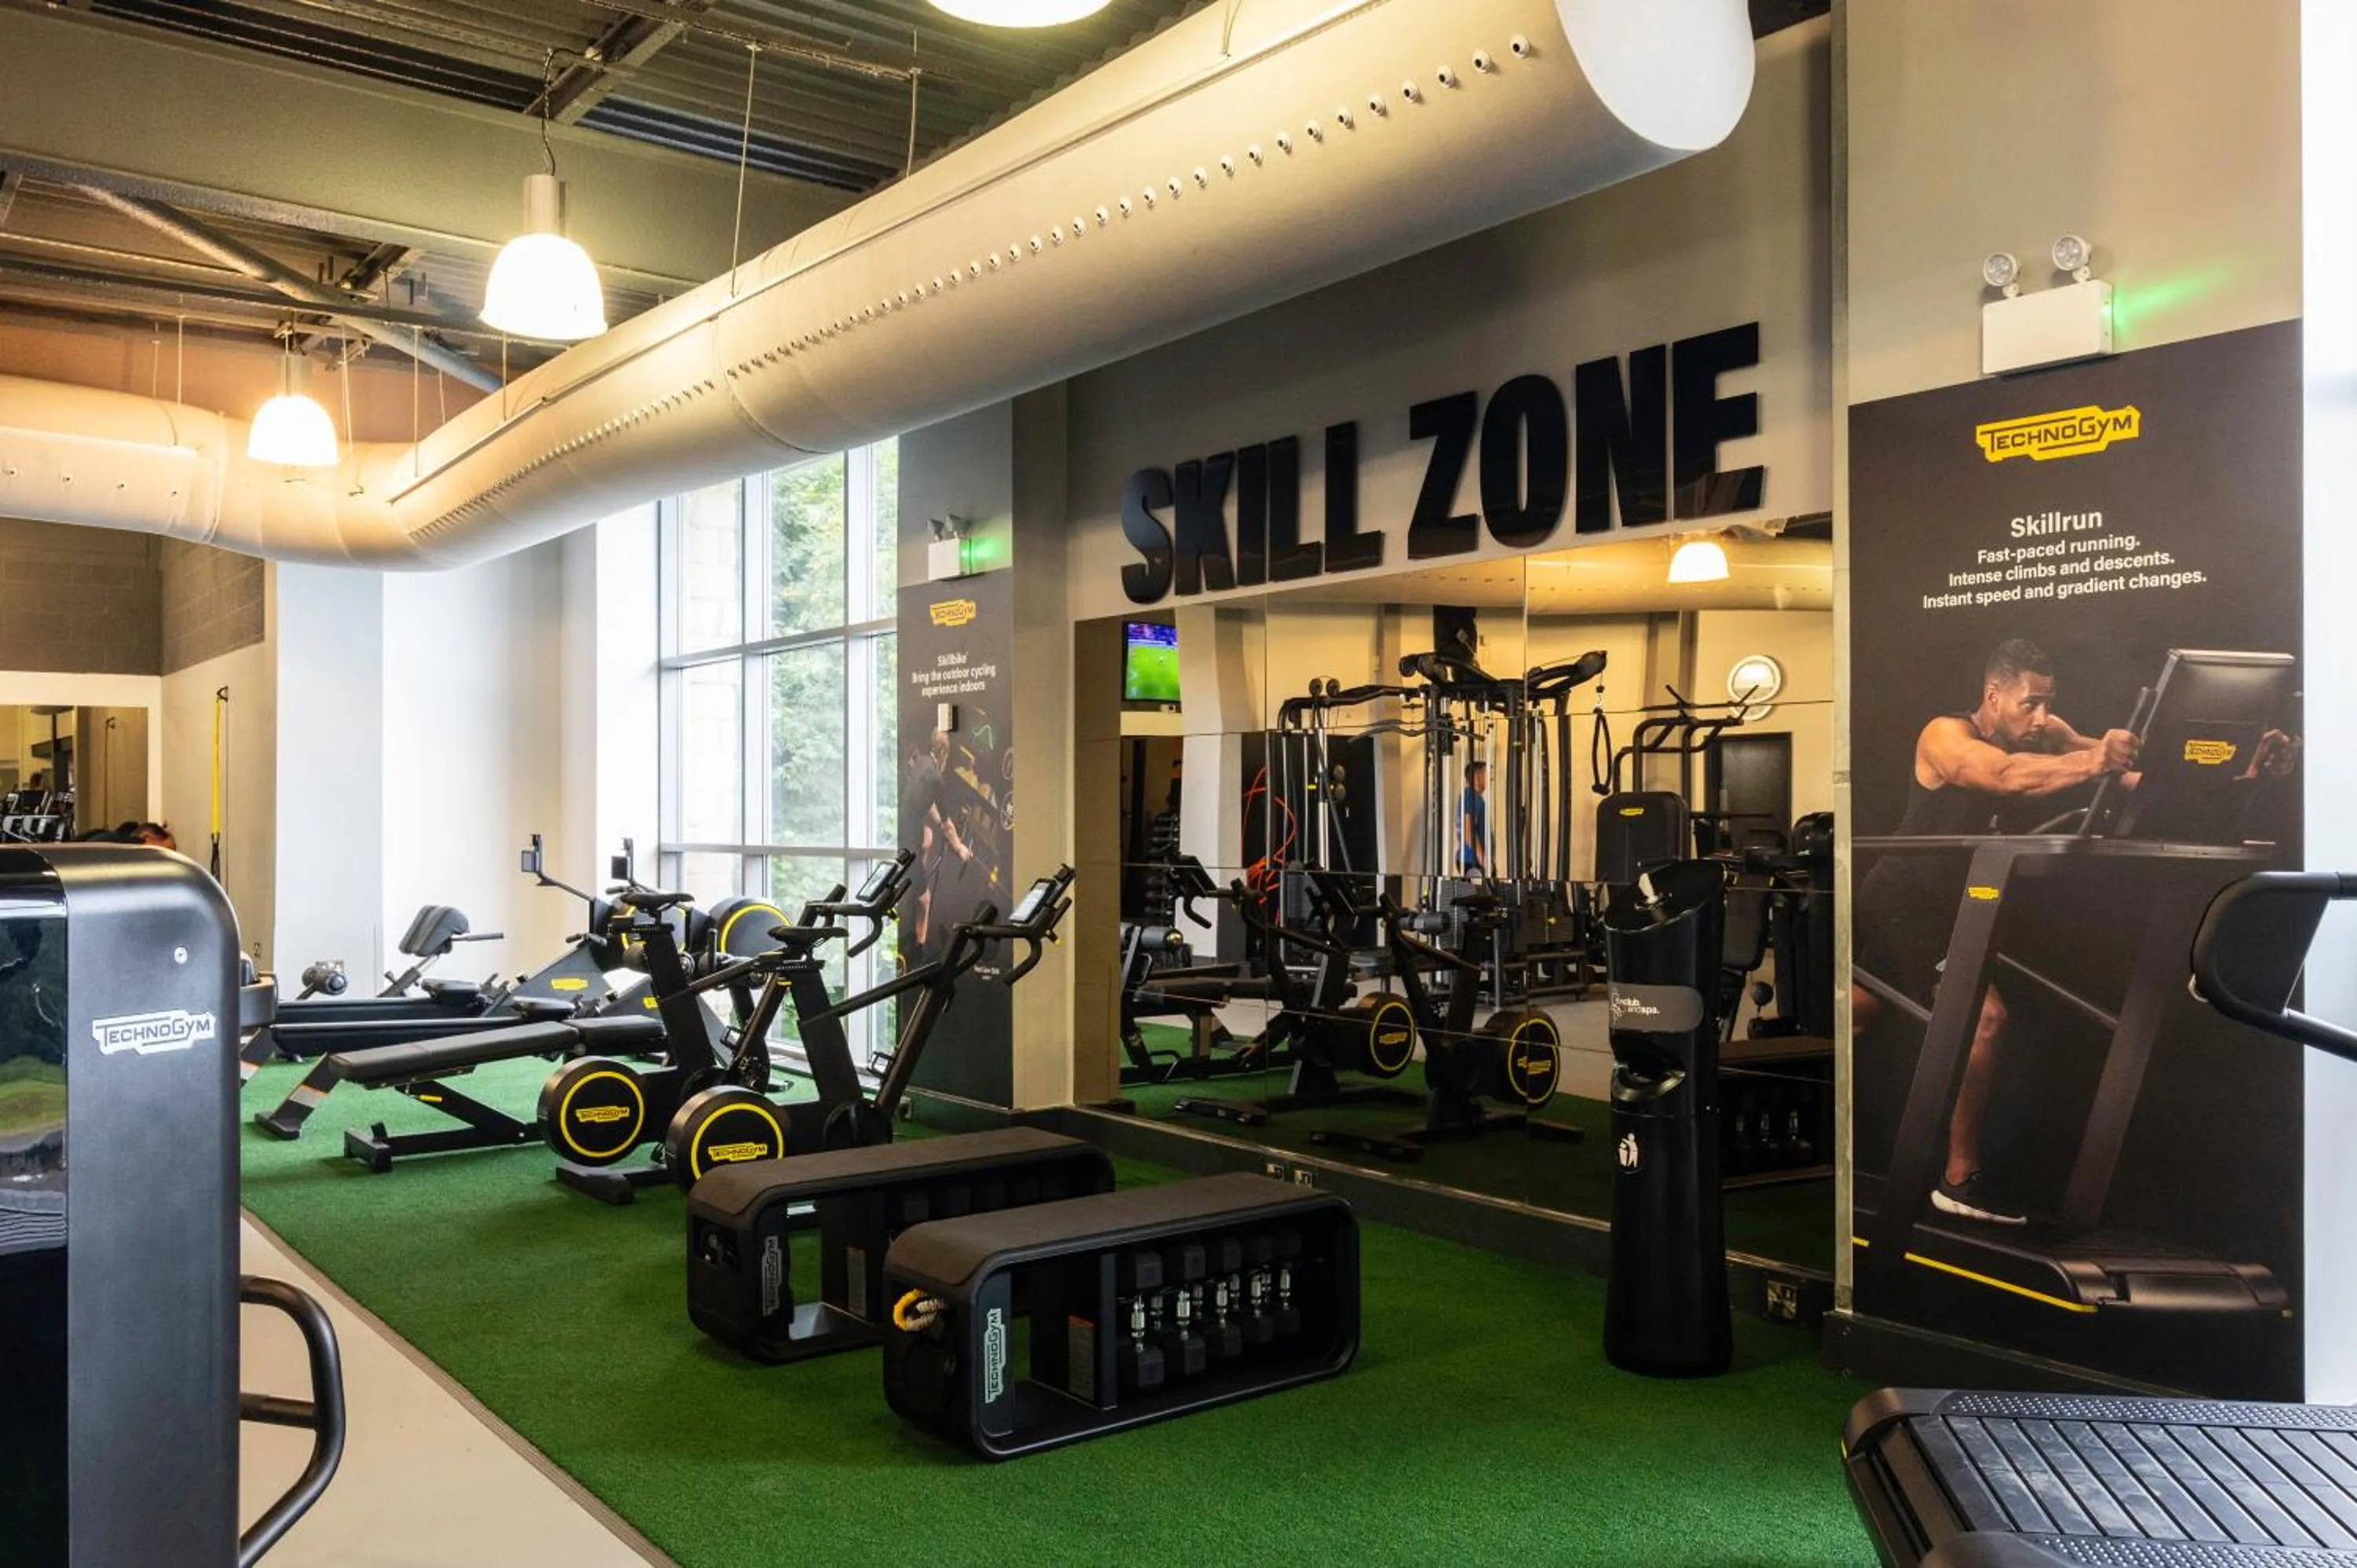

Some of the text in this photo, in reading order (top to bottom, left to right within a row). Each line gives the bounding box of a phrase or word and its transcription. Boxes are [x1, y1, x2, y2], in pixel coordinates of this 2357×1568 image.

[1978, 413, 2134, 454] TECHNOGYM
[1121, 321, 1765, 605] SKILL ZONE
[2011, 511, 2102, 538] Skillrun
[1978, 534, 2141, 564] Fast-paced running.
[1948, 550, 2176, 587] Intense climbs and descents.
[1923, 570, 2207, 609] Instant speed and gradient changes.
[94, 1015, 211, 1048] TECHNOGYM
[987, 1310, 1003, 1401] TECHNOGYM
